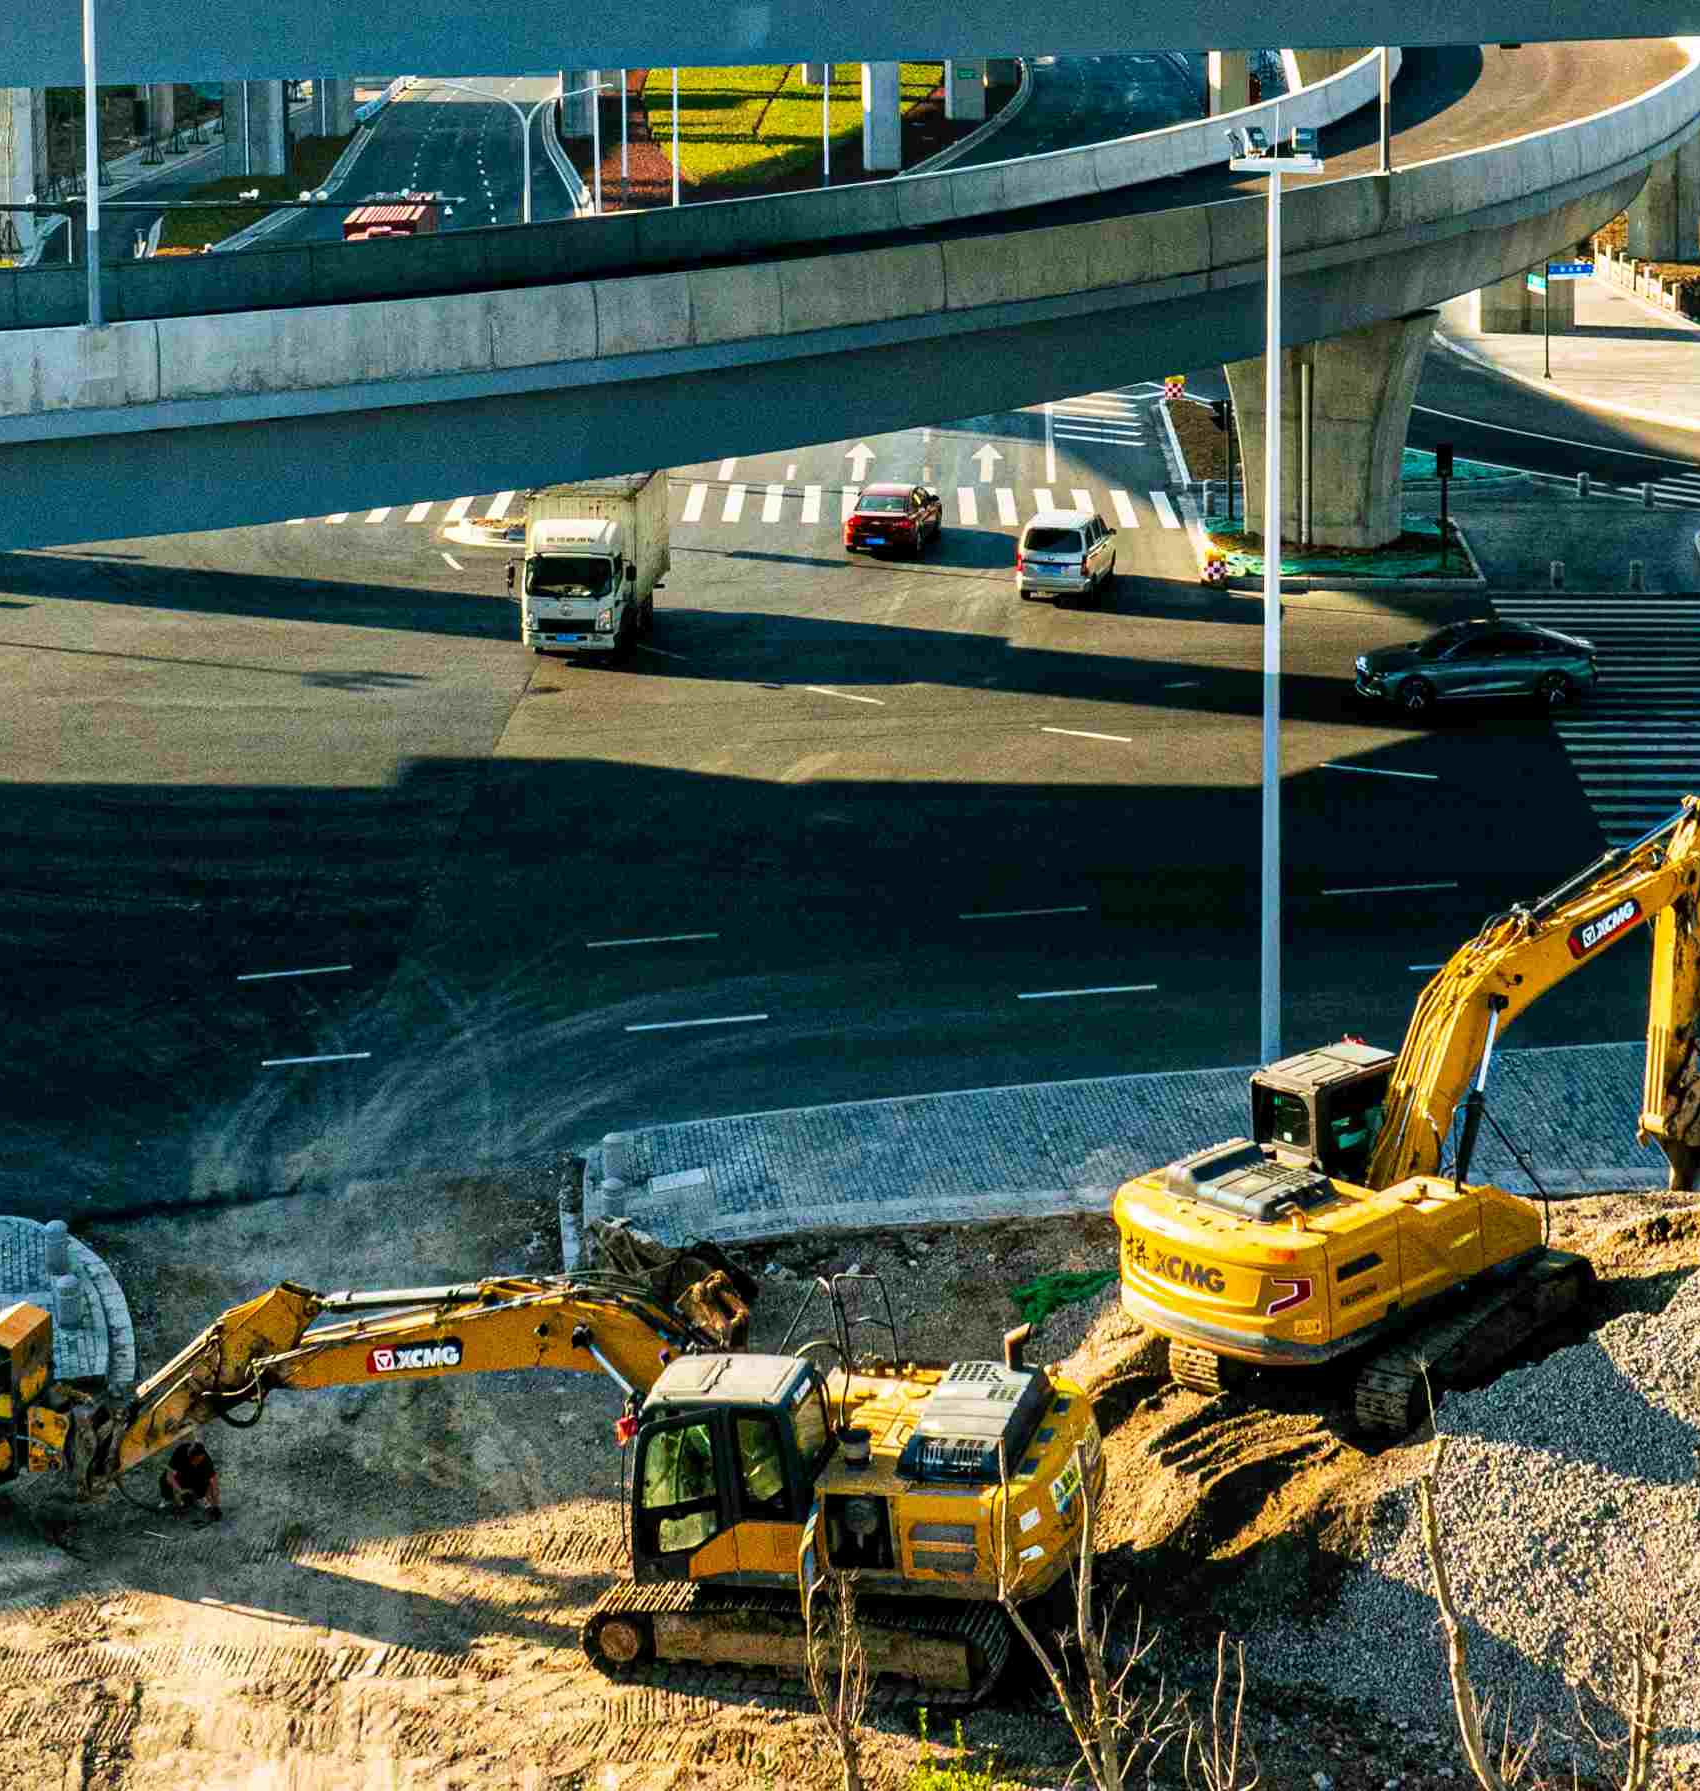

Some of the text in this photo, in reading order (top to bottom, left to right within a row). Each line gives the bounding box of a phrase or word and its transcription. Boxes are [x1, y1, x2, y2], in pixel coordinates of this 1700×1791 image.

[1595, 901, 1636, 941] XCMG
[1155, 1249, 1226, 1294] XCMG
[396, 1346, 460, 1369] XCMG
